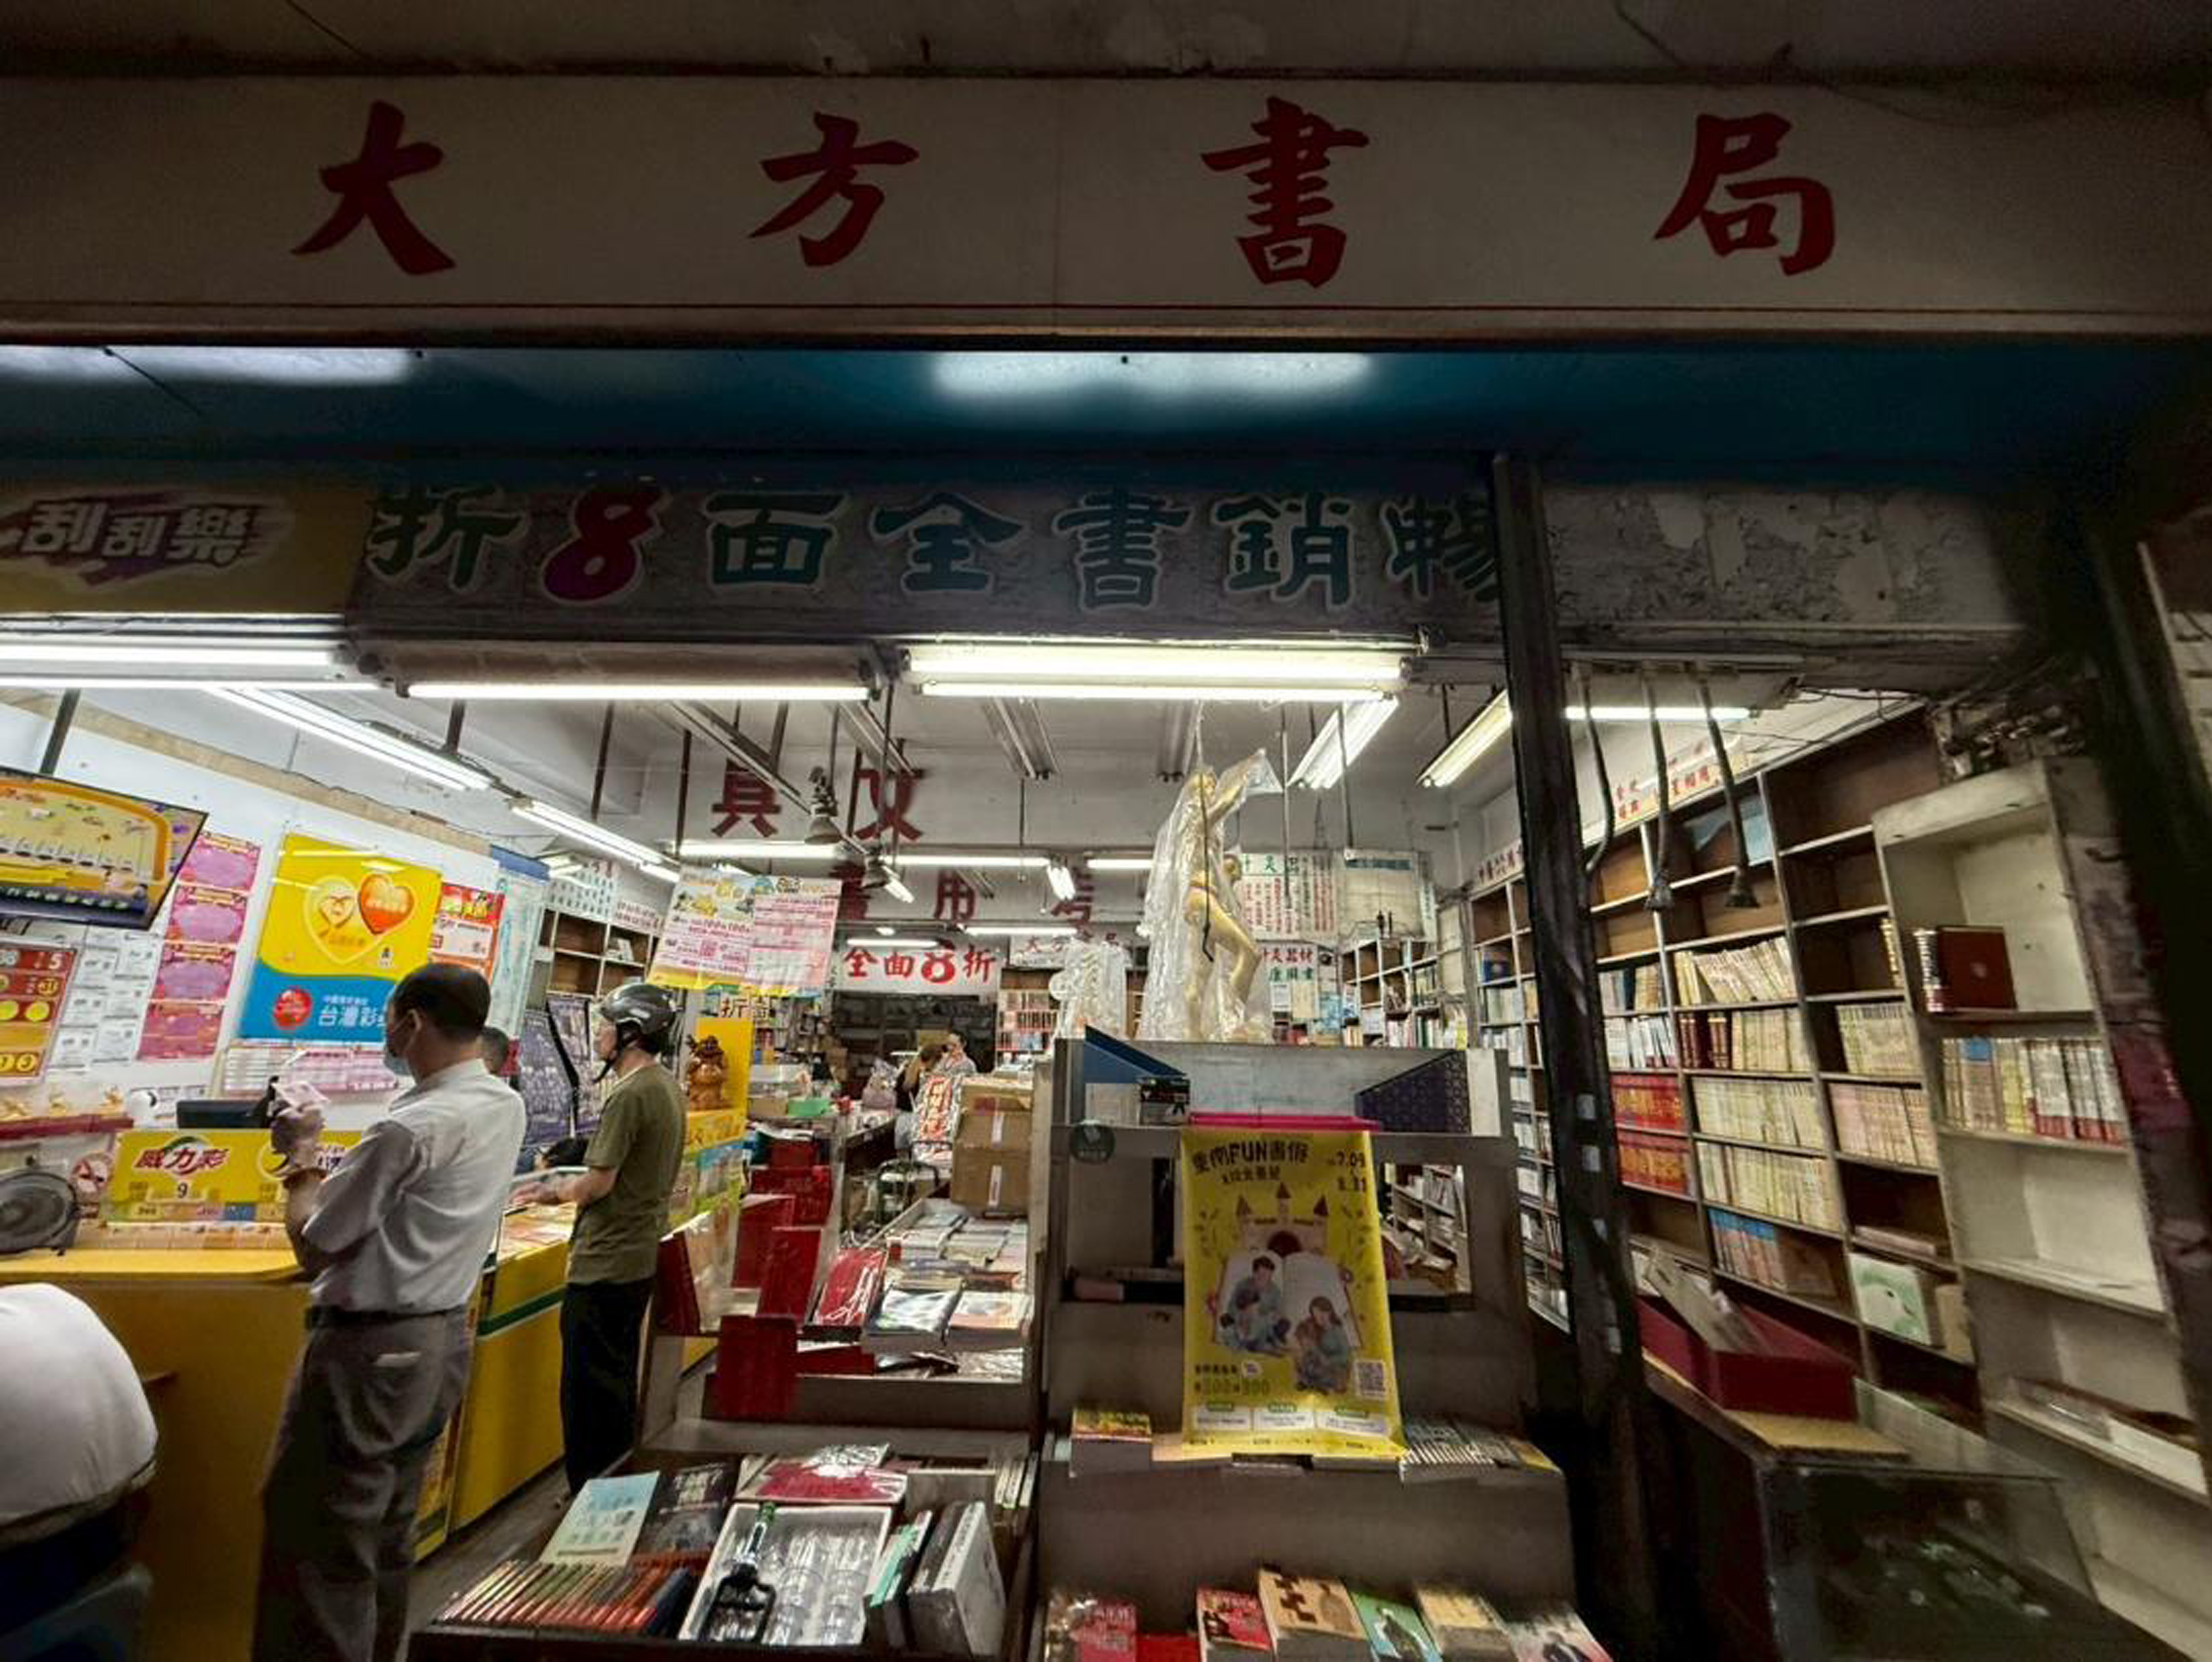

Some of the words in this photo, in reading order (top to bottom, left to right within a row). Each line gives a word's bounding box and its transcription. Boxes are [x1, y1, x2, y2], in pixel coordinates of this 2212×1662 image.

[293, 97, 1837, 289] 大方書局
[21, 501, 252, 566] 刮刮樂
[844, 940, 995, 983] 全面8折
[134, 1148, 230, 1170] 威力彩
